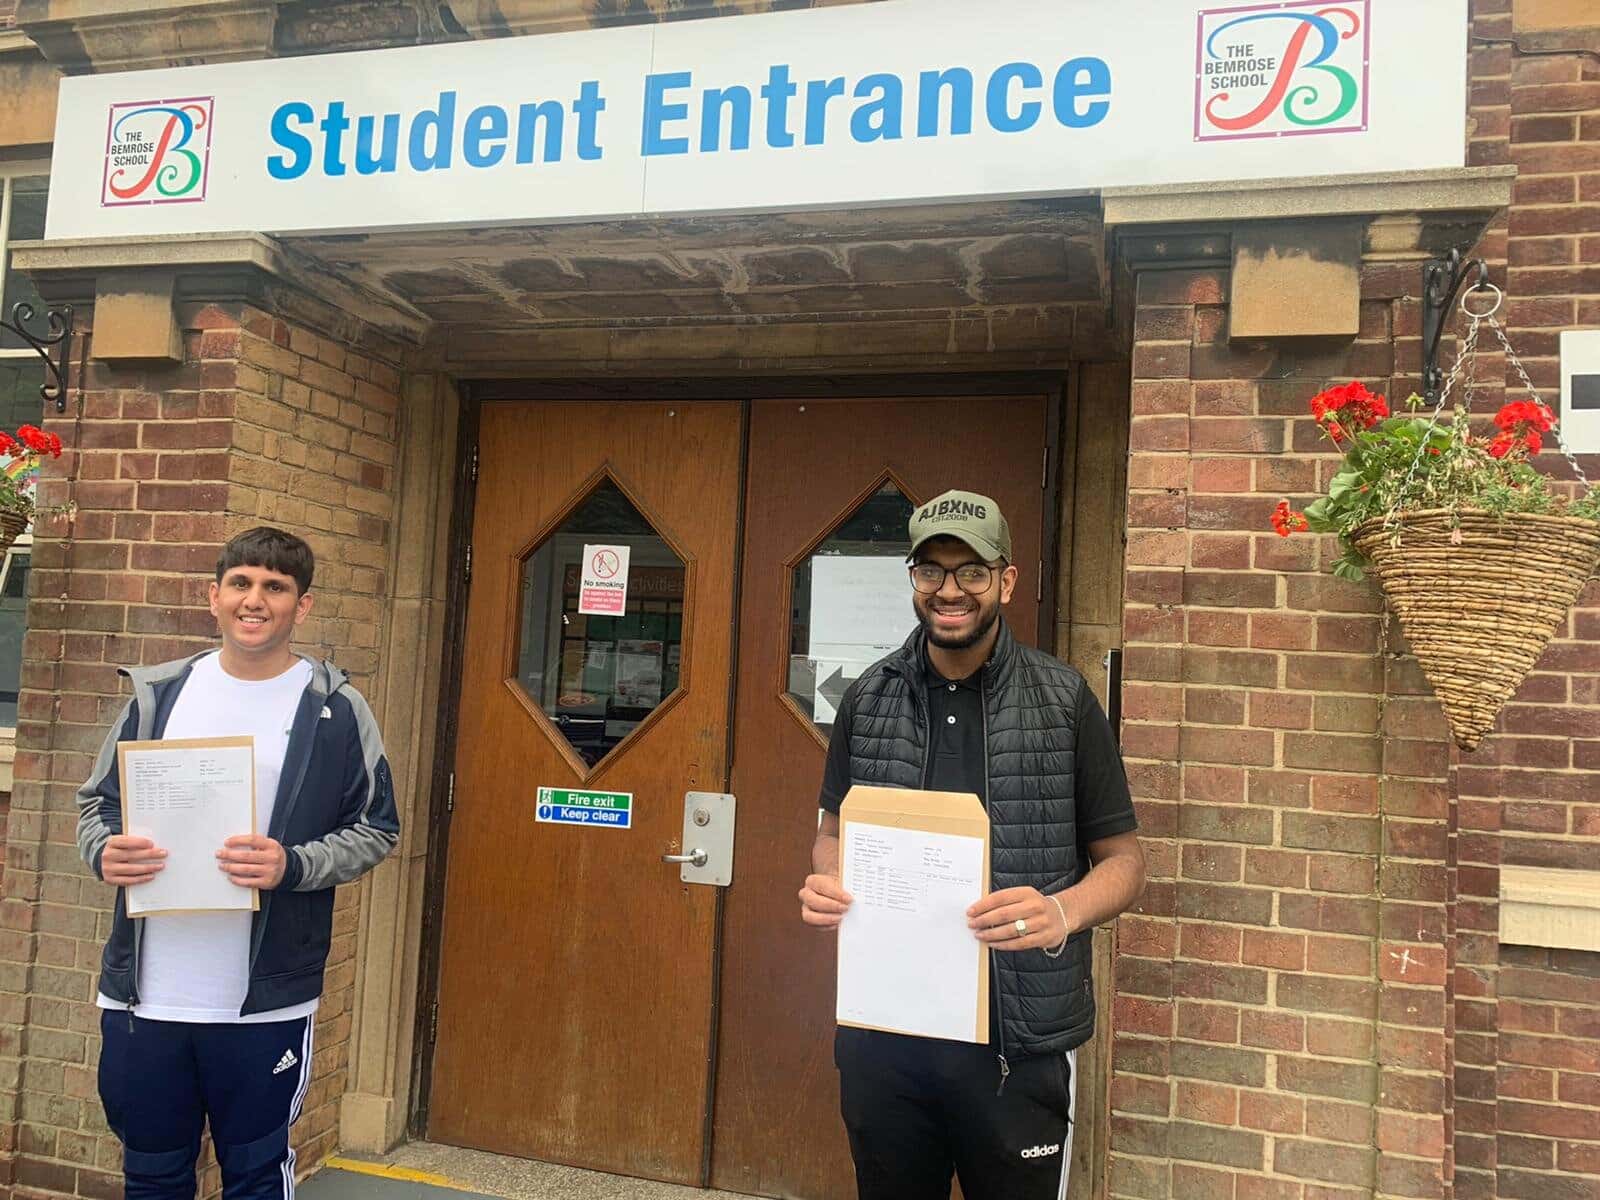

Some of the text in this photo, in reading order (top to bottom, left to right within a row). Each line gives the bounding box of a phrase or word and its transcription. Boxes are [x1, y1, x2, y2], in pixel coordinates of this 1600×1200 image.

[1226, 44, 1254, 58] THE
[1205, 57, 1276, 75] BEMROSE
[1210, 73, 1268, 90] SCHOOL
[266, 57, 1112, 182] Student Entrance
[125, 131, 142, 143] THE
[111, 142, 154, 155] BEMROSE
[113, 154, 149, 167] SCHOOL
[583, 579, 625, 590] No smoking
[567, 793, 615, 808] Fire exit
[560, 807, 621, 822] Keep clear
[1021, 1143, 1060, 1159] adidas
